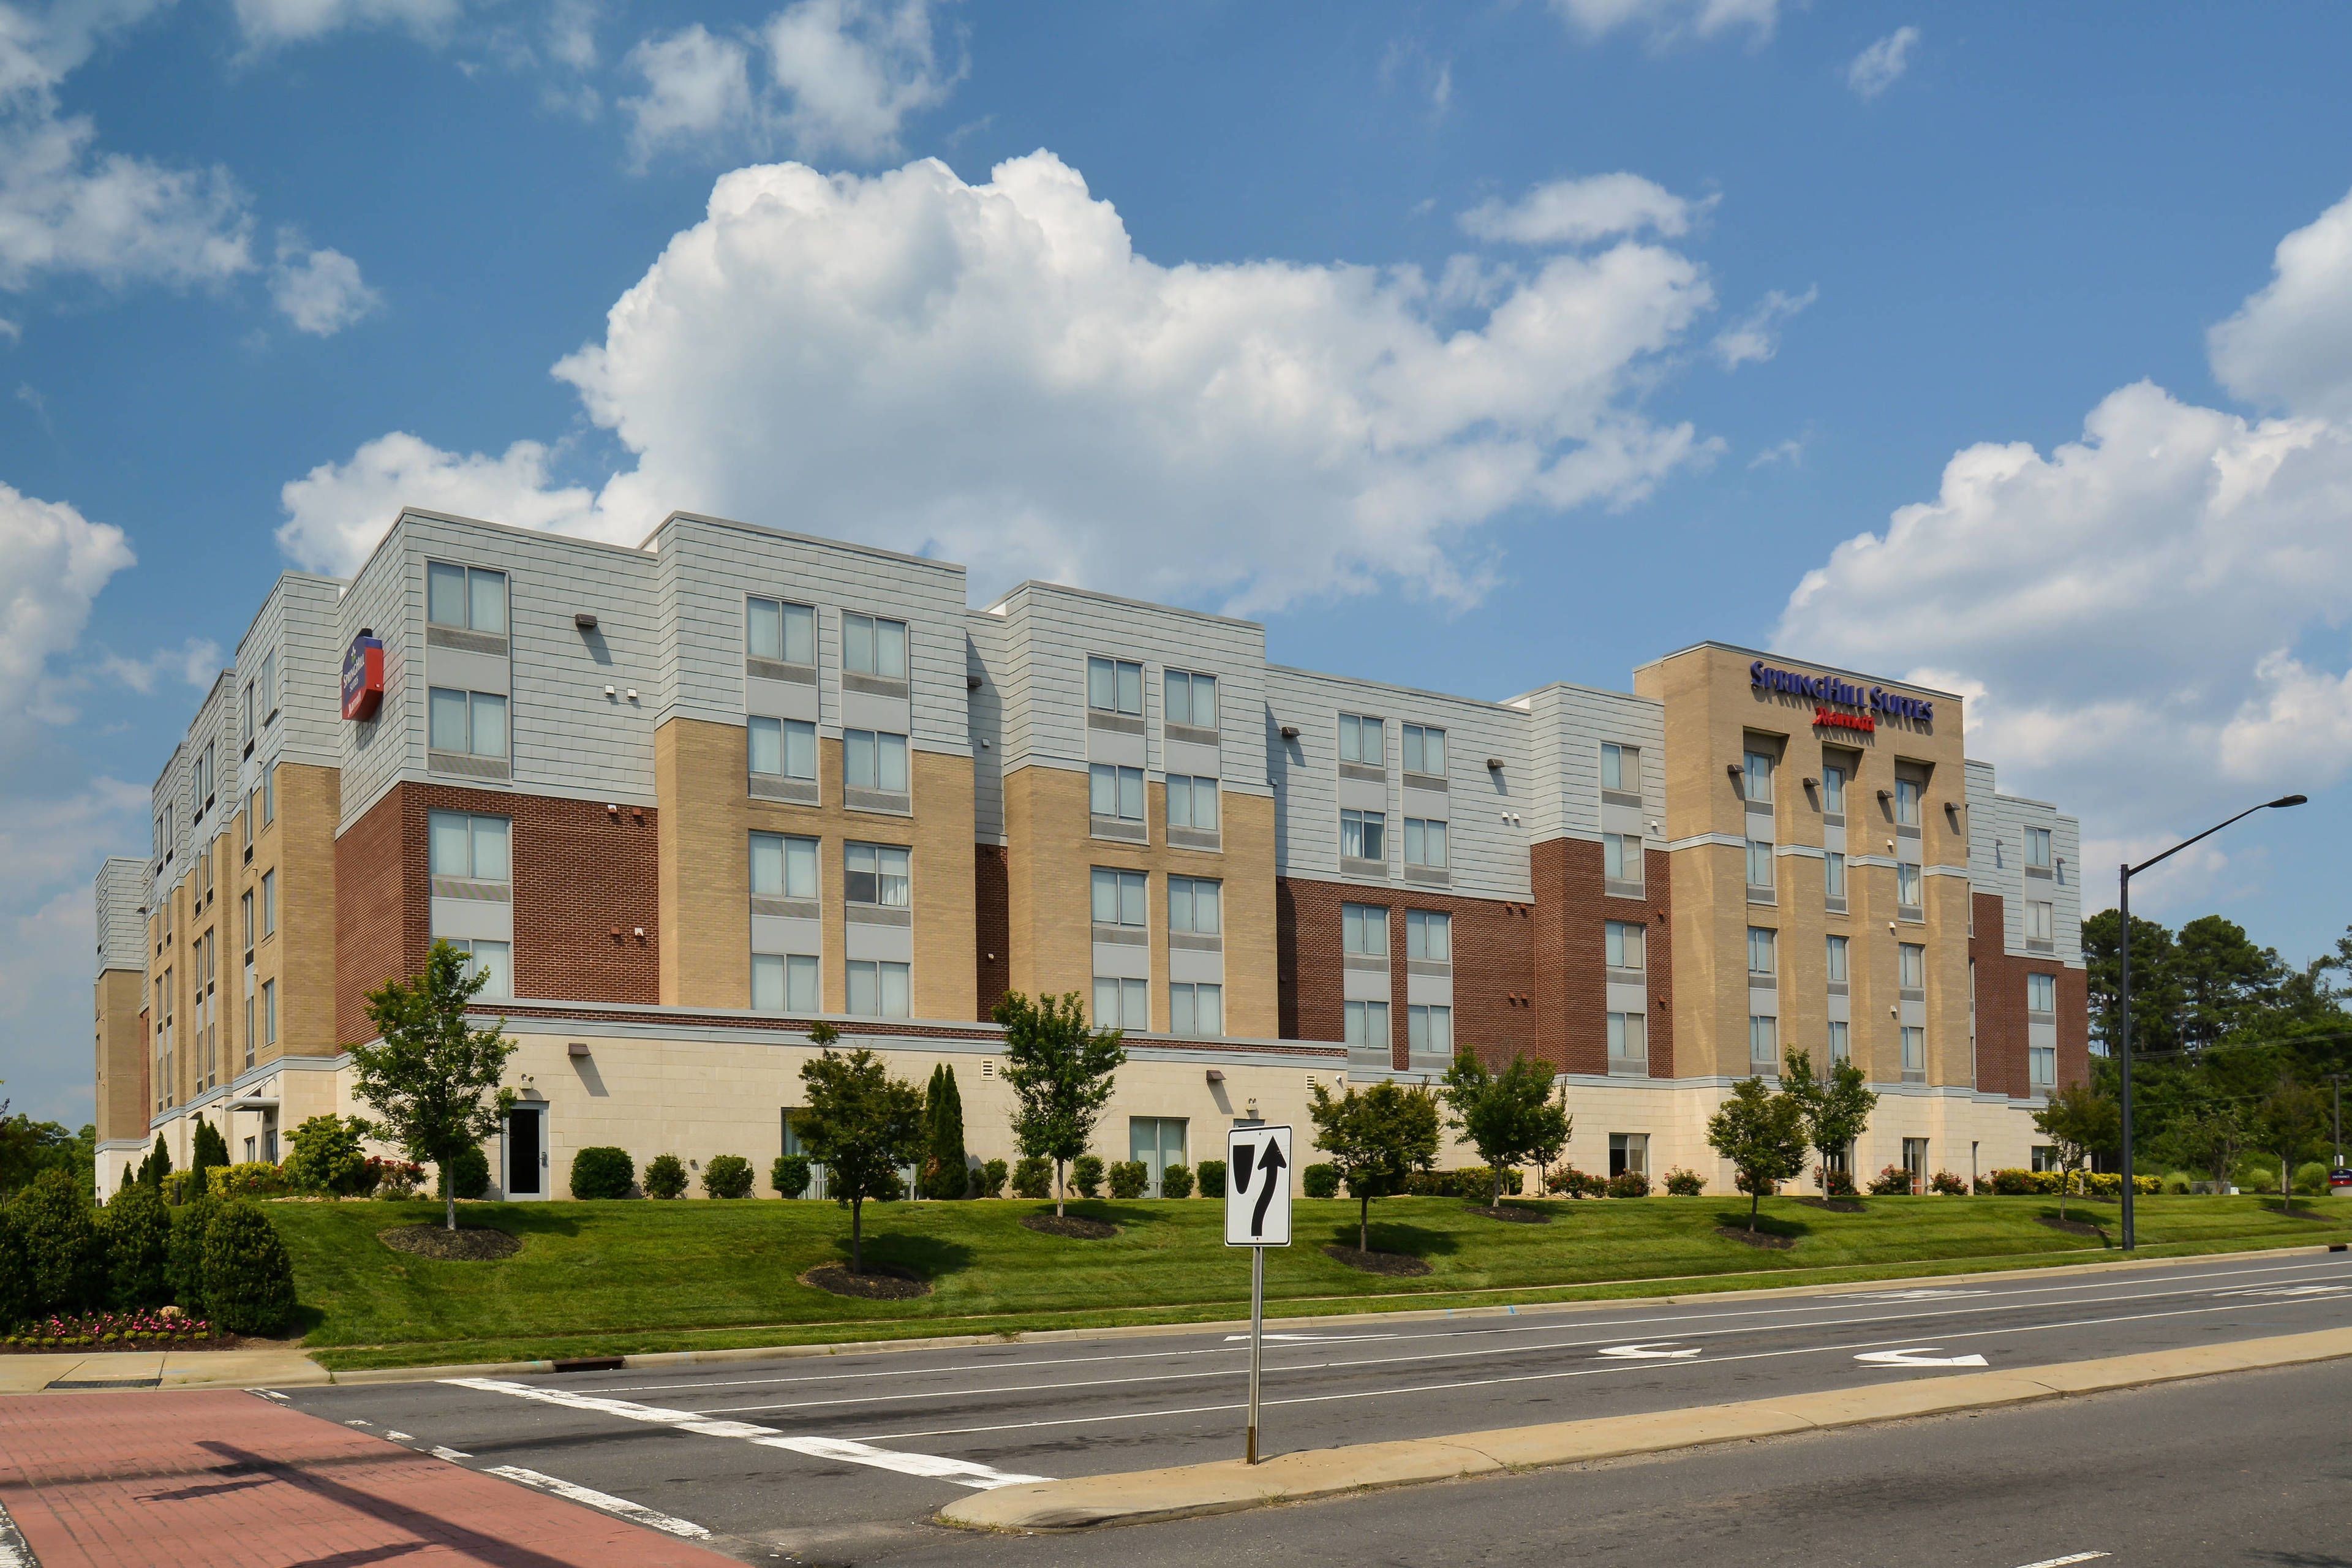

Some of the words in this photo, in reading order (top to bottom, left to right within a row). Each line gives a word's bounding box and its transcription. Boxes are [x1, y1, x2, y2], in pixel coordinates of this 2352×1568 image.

[1750, 660, 1868, 708] SPRINGHILL
[1869, 685, 1934, 723] SUITES
[1812, 706, 1875, 732] Marriott
